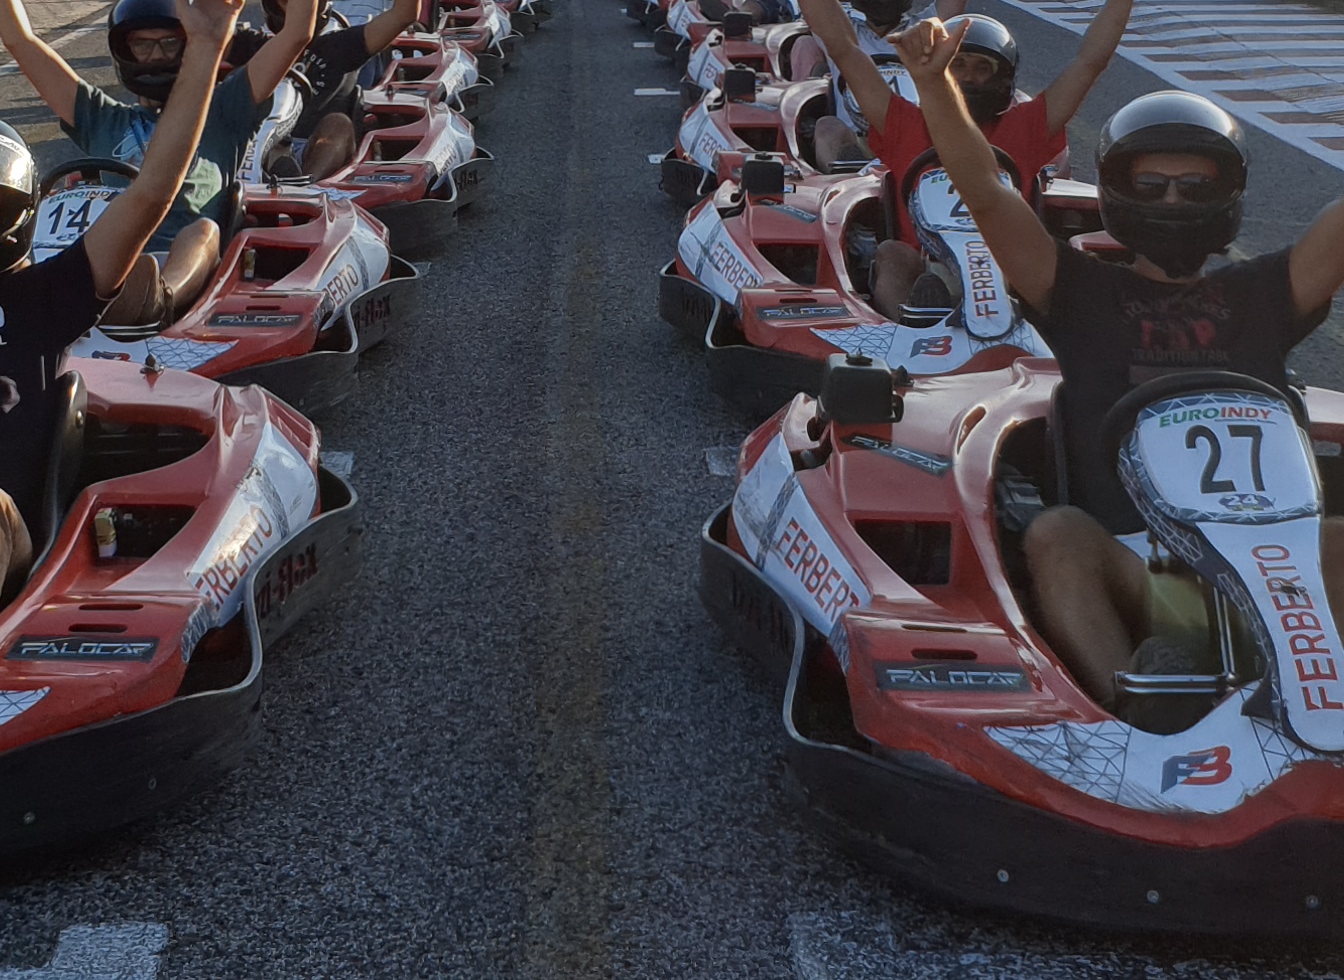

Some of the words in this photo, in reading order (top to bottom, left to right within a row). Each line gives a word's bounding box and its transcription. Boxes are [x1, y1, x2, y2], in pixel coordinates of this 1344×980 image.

[48, 190, 112, 204] EUROIND
[48, 199, 91, 235] 14
[964, 240, 1000, 317] FERBERTO
[1158, 406, 1272, 428] EUROINDY
[1184, 424, 1267, 494] 27
[1262, 543, 1344, 713] FERBERTO
[19, 641, 154, 661] PALOCAR
[885, 669, 1023, 689] PALOCAR
